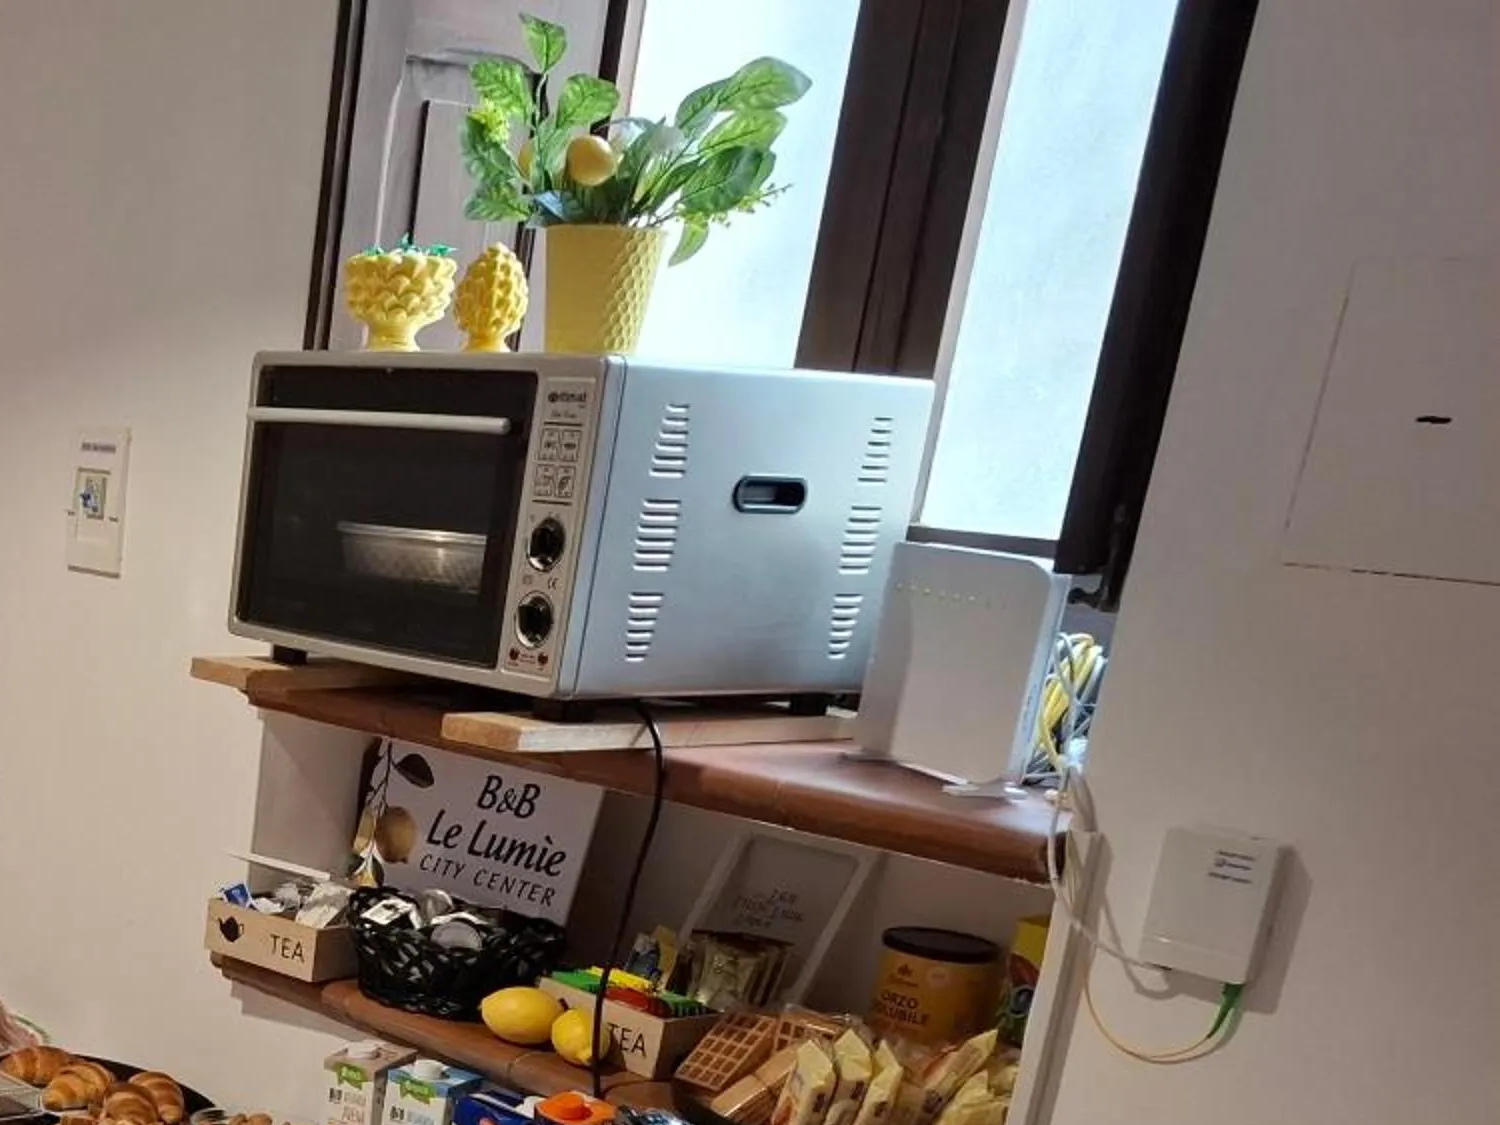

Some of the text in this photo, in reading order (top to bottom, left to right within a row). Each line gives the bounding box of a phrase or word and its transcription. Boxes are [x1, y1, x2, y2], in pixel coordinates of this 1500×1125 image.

[477, 775, 541, 818] B&B
[426, 809, 463, 849] Le
[420, 854, 556, 907] CITY CENTER
[270, 933, 305, 964] TEA
[607, 1022, 647, 1058] TEA
